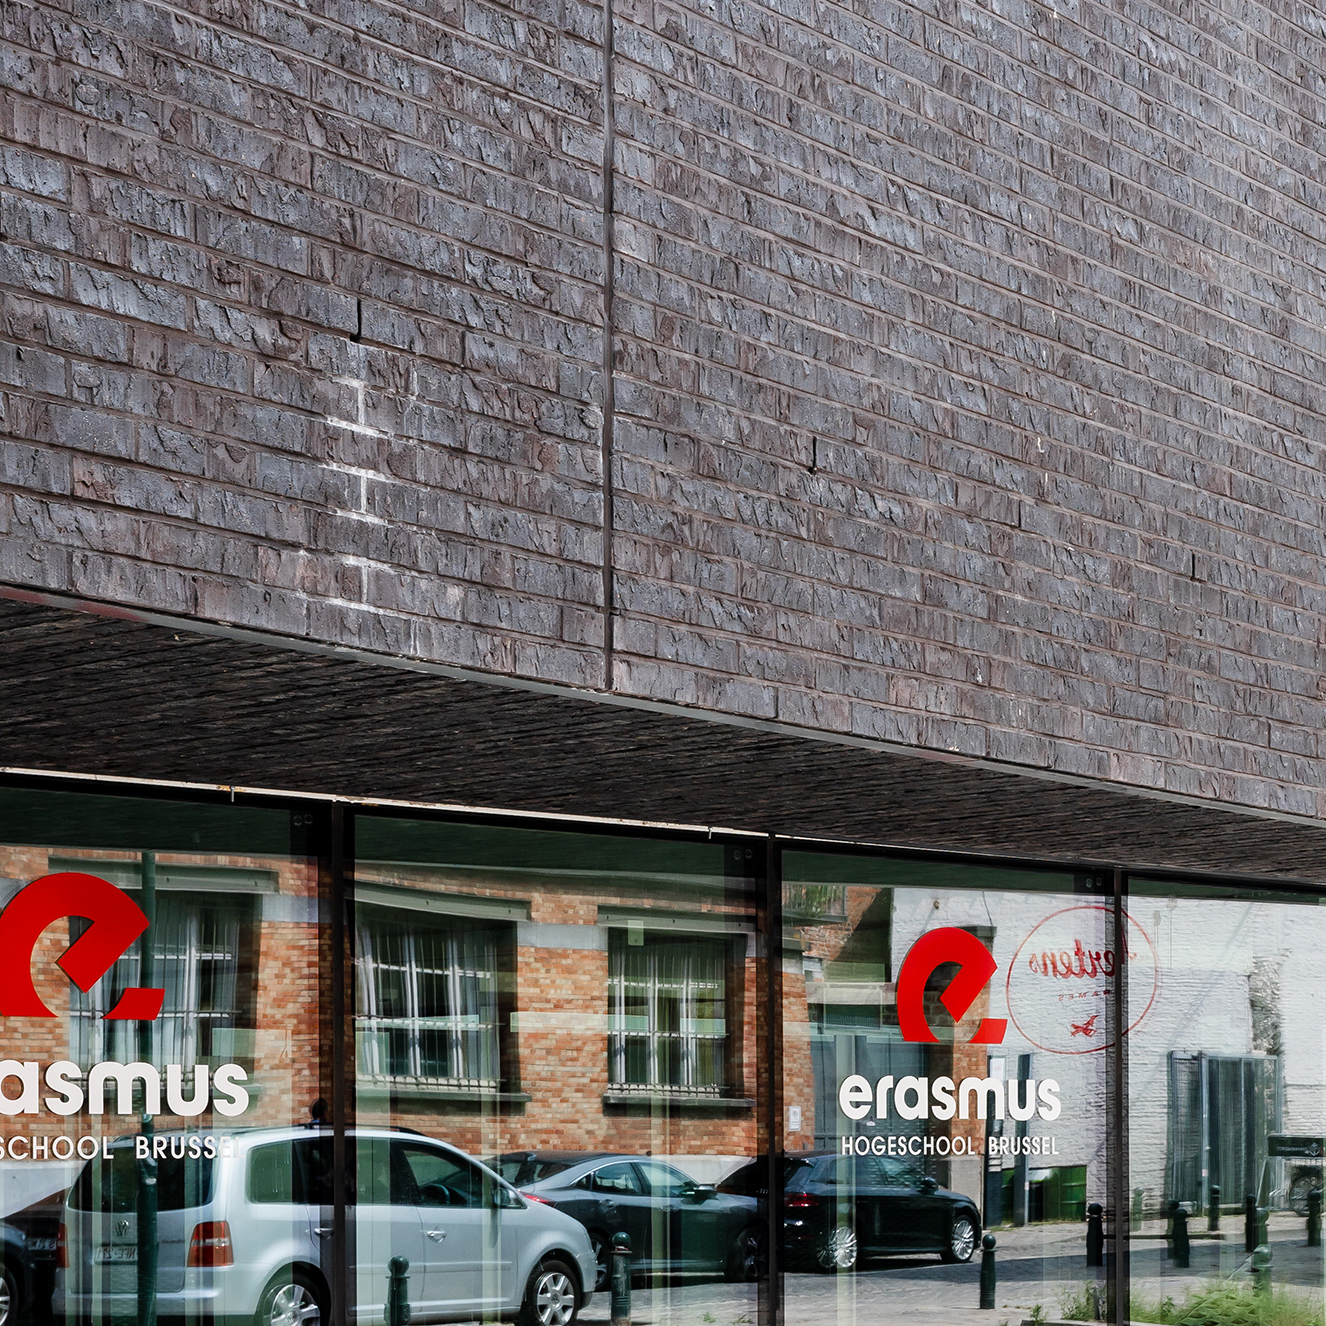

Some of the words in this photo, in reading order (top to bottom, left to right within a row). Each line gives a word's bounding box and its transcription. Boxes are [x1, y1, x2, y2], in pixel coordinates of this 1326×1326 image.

[839, 1074, 1062, 1121] erasmus
[135, 1135, 247, 1160] BRUSSEL
[841, 1135, 975, 1156] HOGESCHOOL
[988, 1135, 1059, 1155] BRUSSEL
